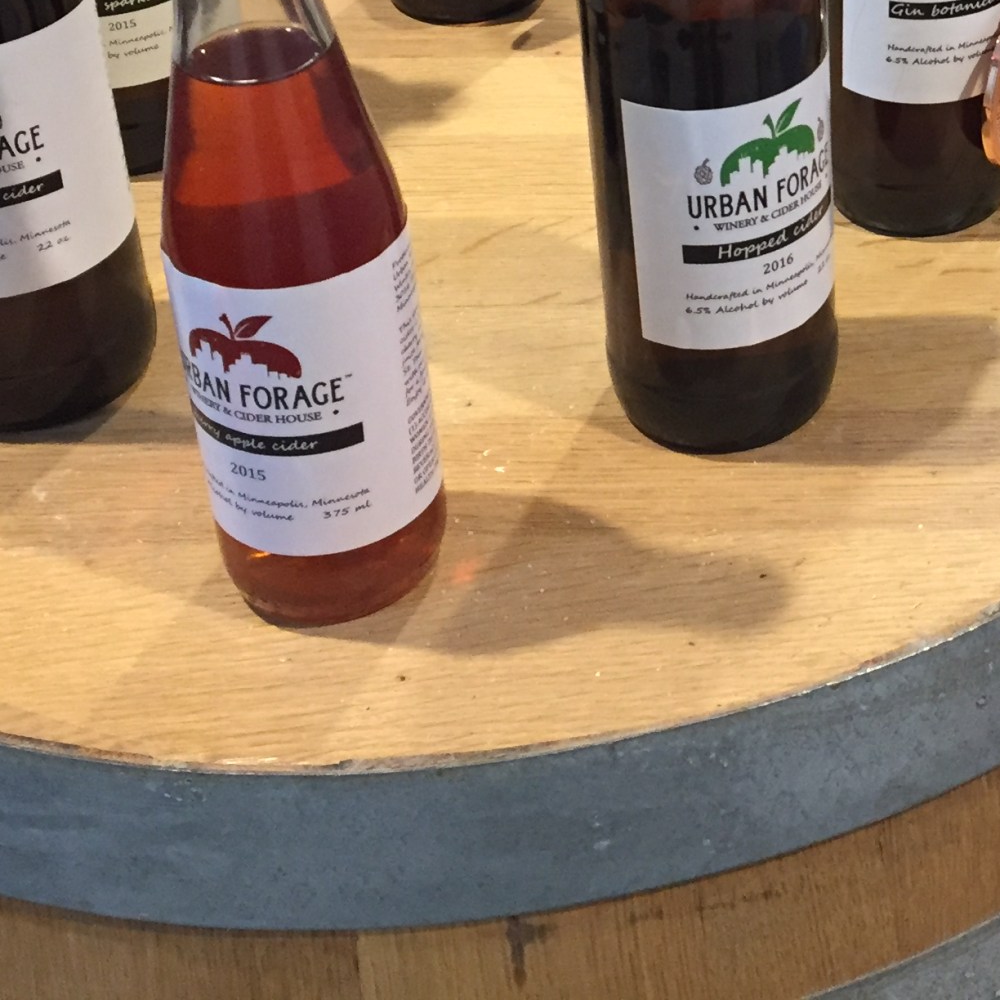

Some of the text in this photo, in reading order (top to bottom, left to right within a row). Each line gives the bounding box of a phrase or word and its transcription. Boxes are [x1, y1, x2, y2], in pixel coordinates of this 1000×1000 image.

[890, 3, 925, 16] Gin
[109, 19, 137, 31] 2015
[123, 43, 160, 57] volume
[887, 43, 943, 54] Handcrafted
[912, 57, 951, 65] Alcohol
[953, 55, 965, 64] by
[3, 182, 44, 201] cider
[687, 185, 768, 219] URBAN
[713, 216, 758, 231] WINERY
[760, 215, 769, 223] &
[771, 201, 799, 218] CIDER
[20, 219, 71, 242] Minnesota
[37, 240, 53, 252] 22
[718, 230, 789, 260] Hopped
[763, 252, 795, 275] 2016
[686, 288, 750, 301] Handcrafted
[752, 287, 764, 295] in
[715, 301, 758, 315] Alcohol
[762, 297, 775, 306] by
[778, 279, 809, 301] volume
[239, 377, 345, 411] FORAGE
[234, 410, 273, 424] CIDER
[275, 411, 322, 424] HOUSE
[225, 433, 319, 451] apple cider
[230, 462, 267, 481] 2015
[312, 487, 370, 507] Minnesota
[252, 509, 294, 522] volume
[323, 507, 350, 520] 375
